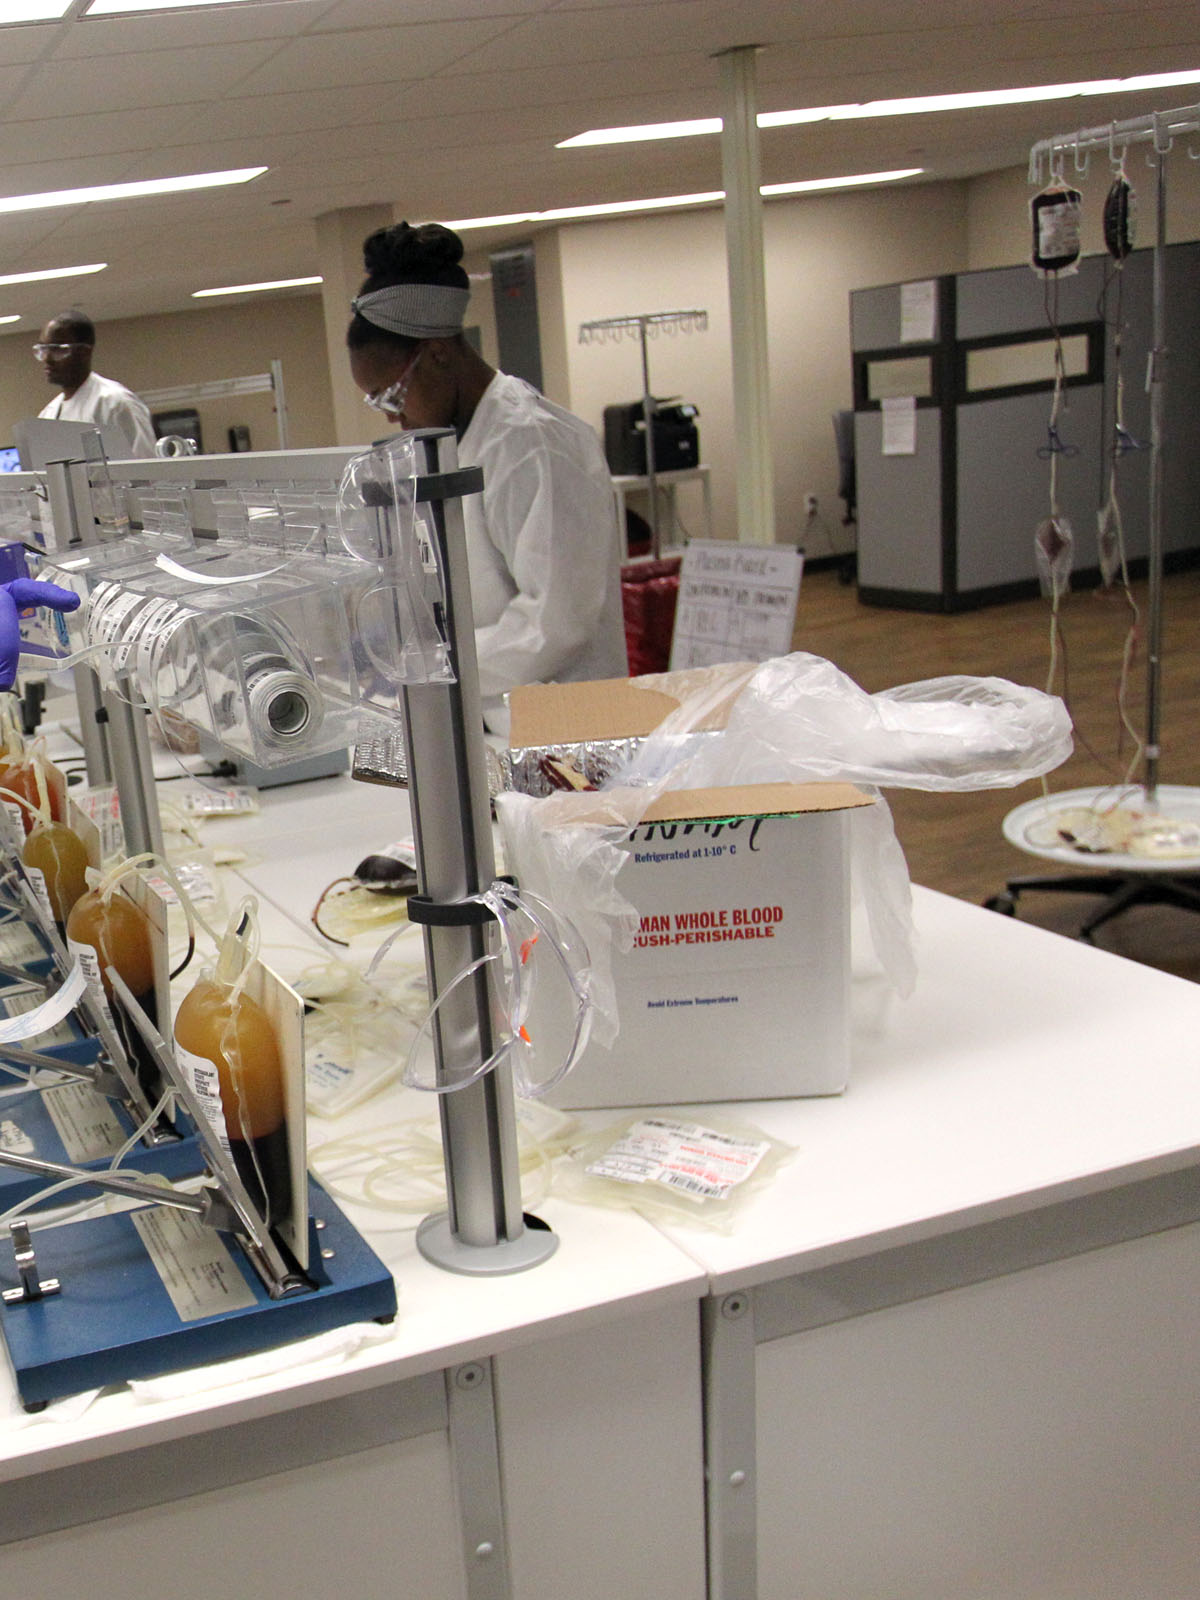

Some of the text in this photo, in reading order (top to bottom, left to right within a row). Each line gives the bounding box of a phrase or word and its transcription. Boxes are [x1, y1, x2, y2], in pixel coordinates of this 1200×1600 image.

[634, 848, 690, 863] Refrigerated
[692, 847, 702, 859] at
[729, 844, 737, 855] C
[638, 906, 784, 933] MAN WHOLE BLOOD
